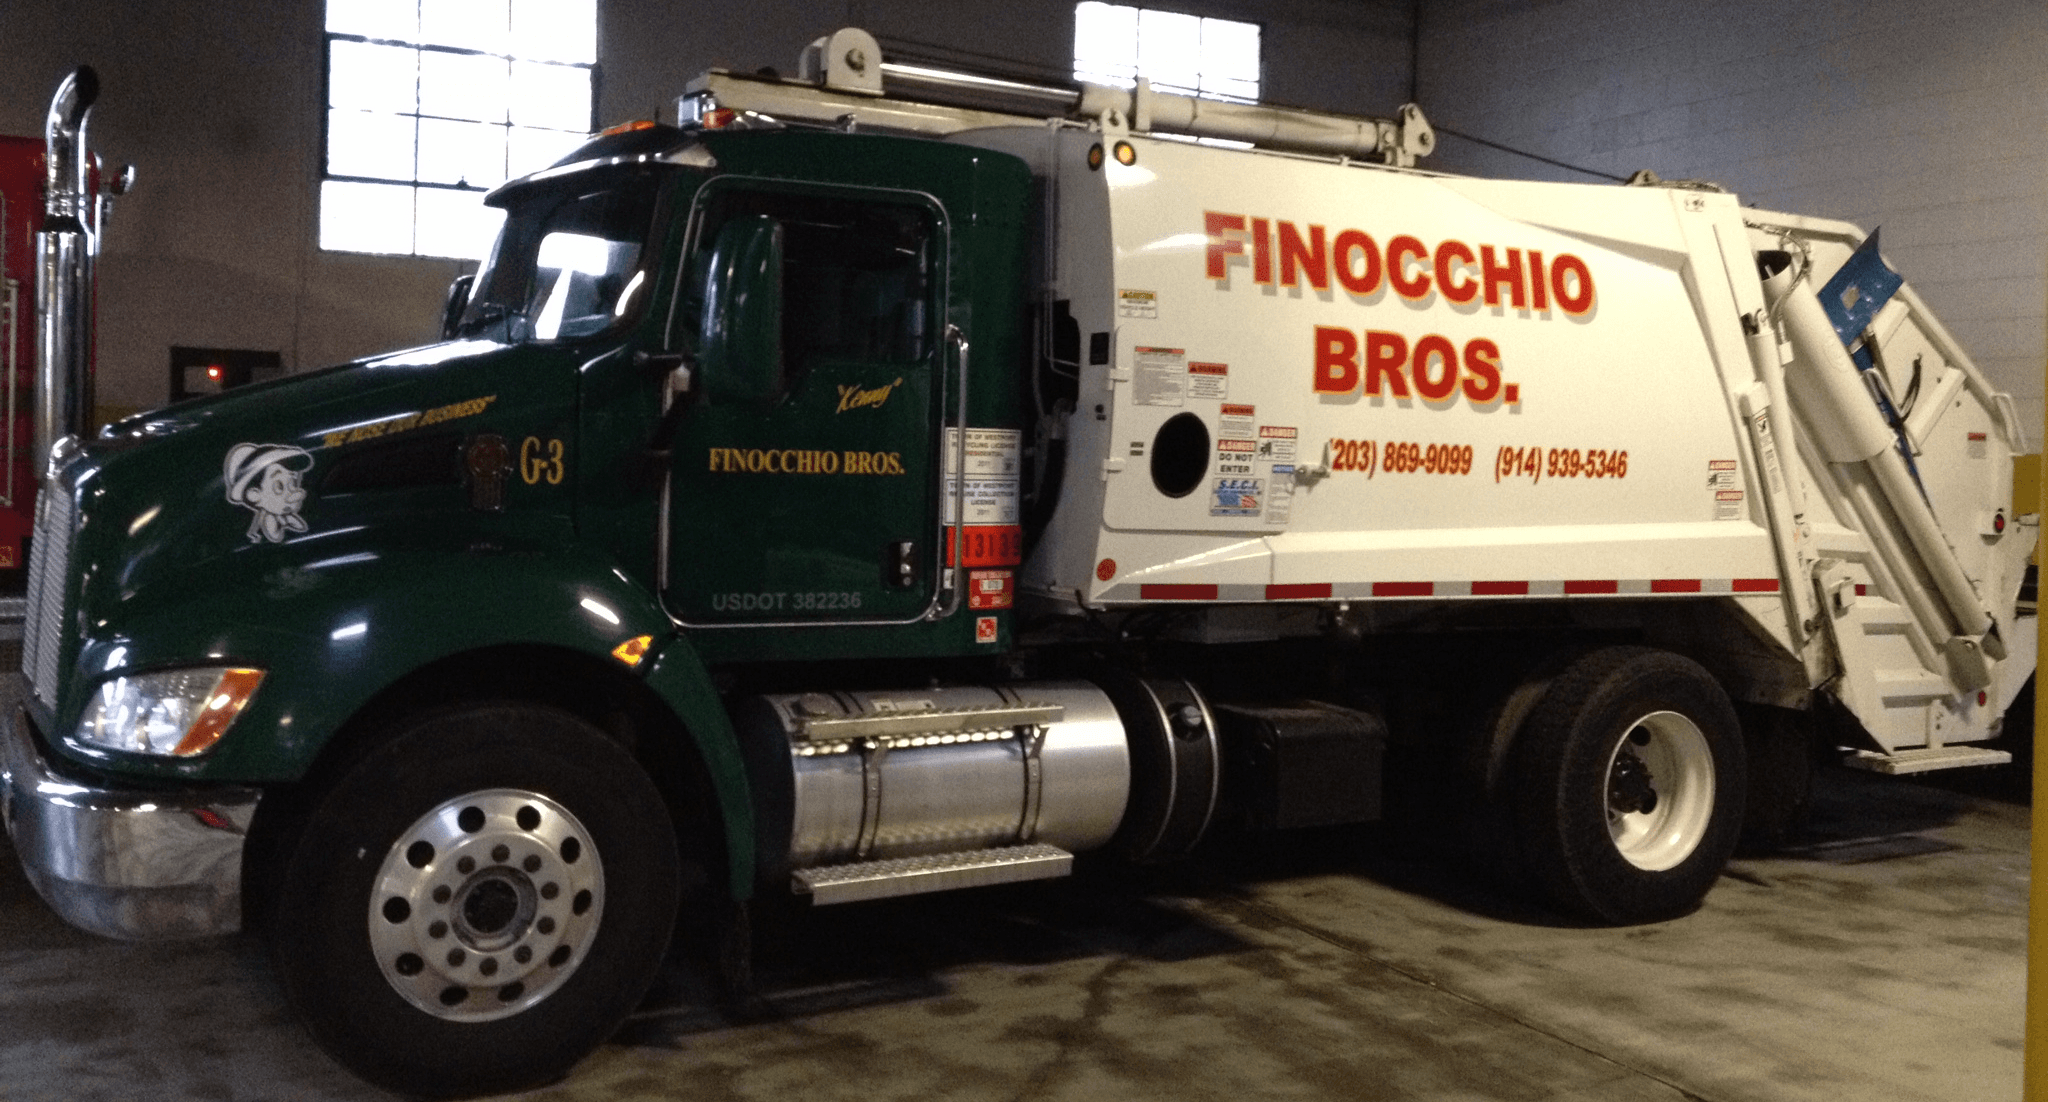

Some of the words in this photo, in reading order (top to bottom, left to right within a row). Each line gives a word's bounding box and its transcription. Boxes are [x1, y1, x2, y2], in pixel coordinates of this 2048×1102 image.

[1203, 211, 1596, 318] FINOCCHIO
[1312, 325, 1520, 406] BROS.
[520, 435, 564, 485] G-3
[1219, 452, 1232, 461] DO
[1235, 453, 1253, 462] NOT
[1226, 441, 1255, 451] DANGER
[709, 447, 840, 473] FINOCCHIO
[843, 450, 906, 475] BROS.
[1220, 464, 1250, 473] ENTER
[1330, 438, 1377, 480] 203)
[1383, 441, 1473, 475] 869-9099
[1495, 445, 1542, 484] (914)
[1547, 448, 1628, 479] 939-5346
[712, 592, 787, 611] USDOT
[792, 591, 863, 610] 382236
